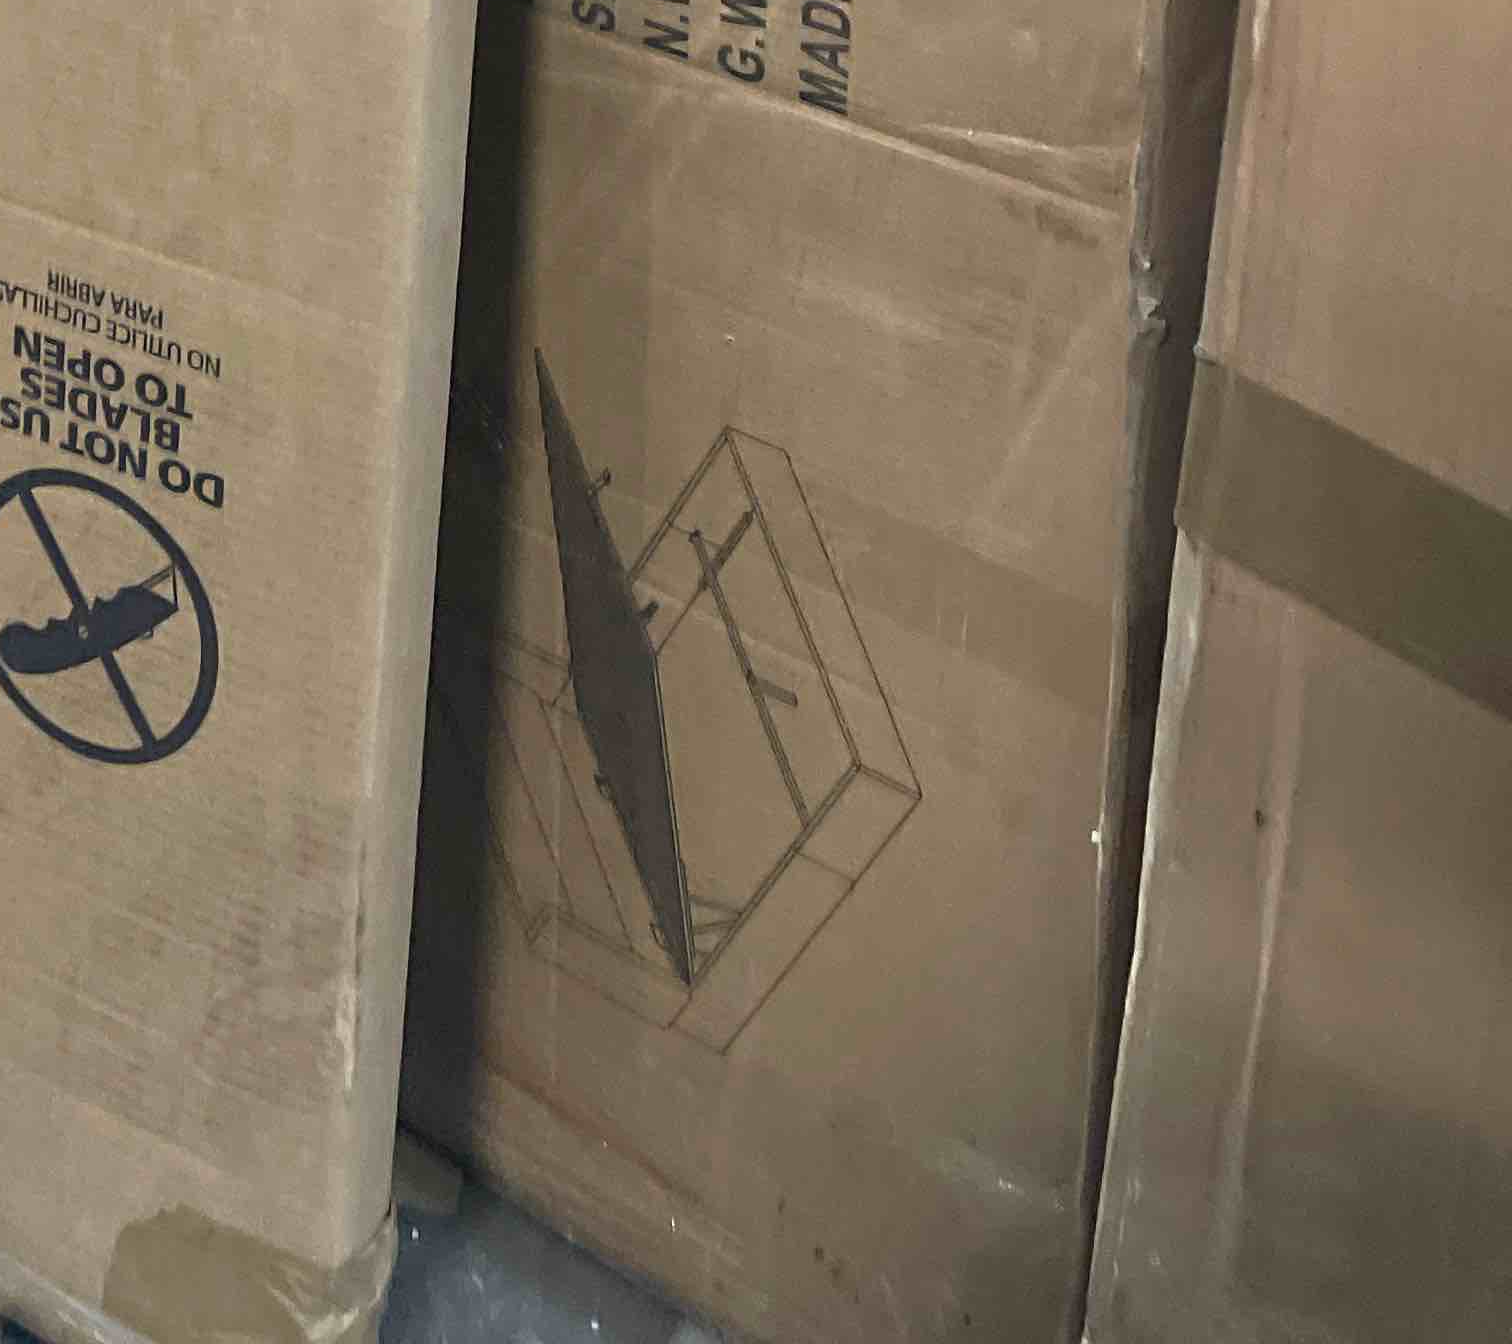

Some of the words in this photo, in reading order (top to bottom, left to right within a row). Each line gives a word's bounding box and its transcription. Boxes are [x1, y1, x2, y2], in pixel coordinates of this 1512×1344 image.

[48, 268, 106, 307] ABRIR
[112, 294, 163, 329] PARA
[14, 324, 125, 393] OPEN
[107, 319, 181, 365] UTILICE
[187, 352, 220, 380] NO
[20, 366, 180, 453] BLADES
[135, 371, 193, 420] TO
[60, 422, 149, 481] NOT
[159, 458, 224, 509] DO
